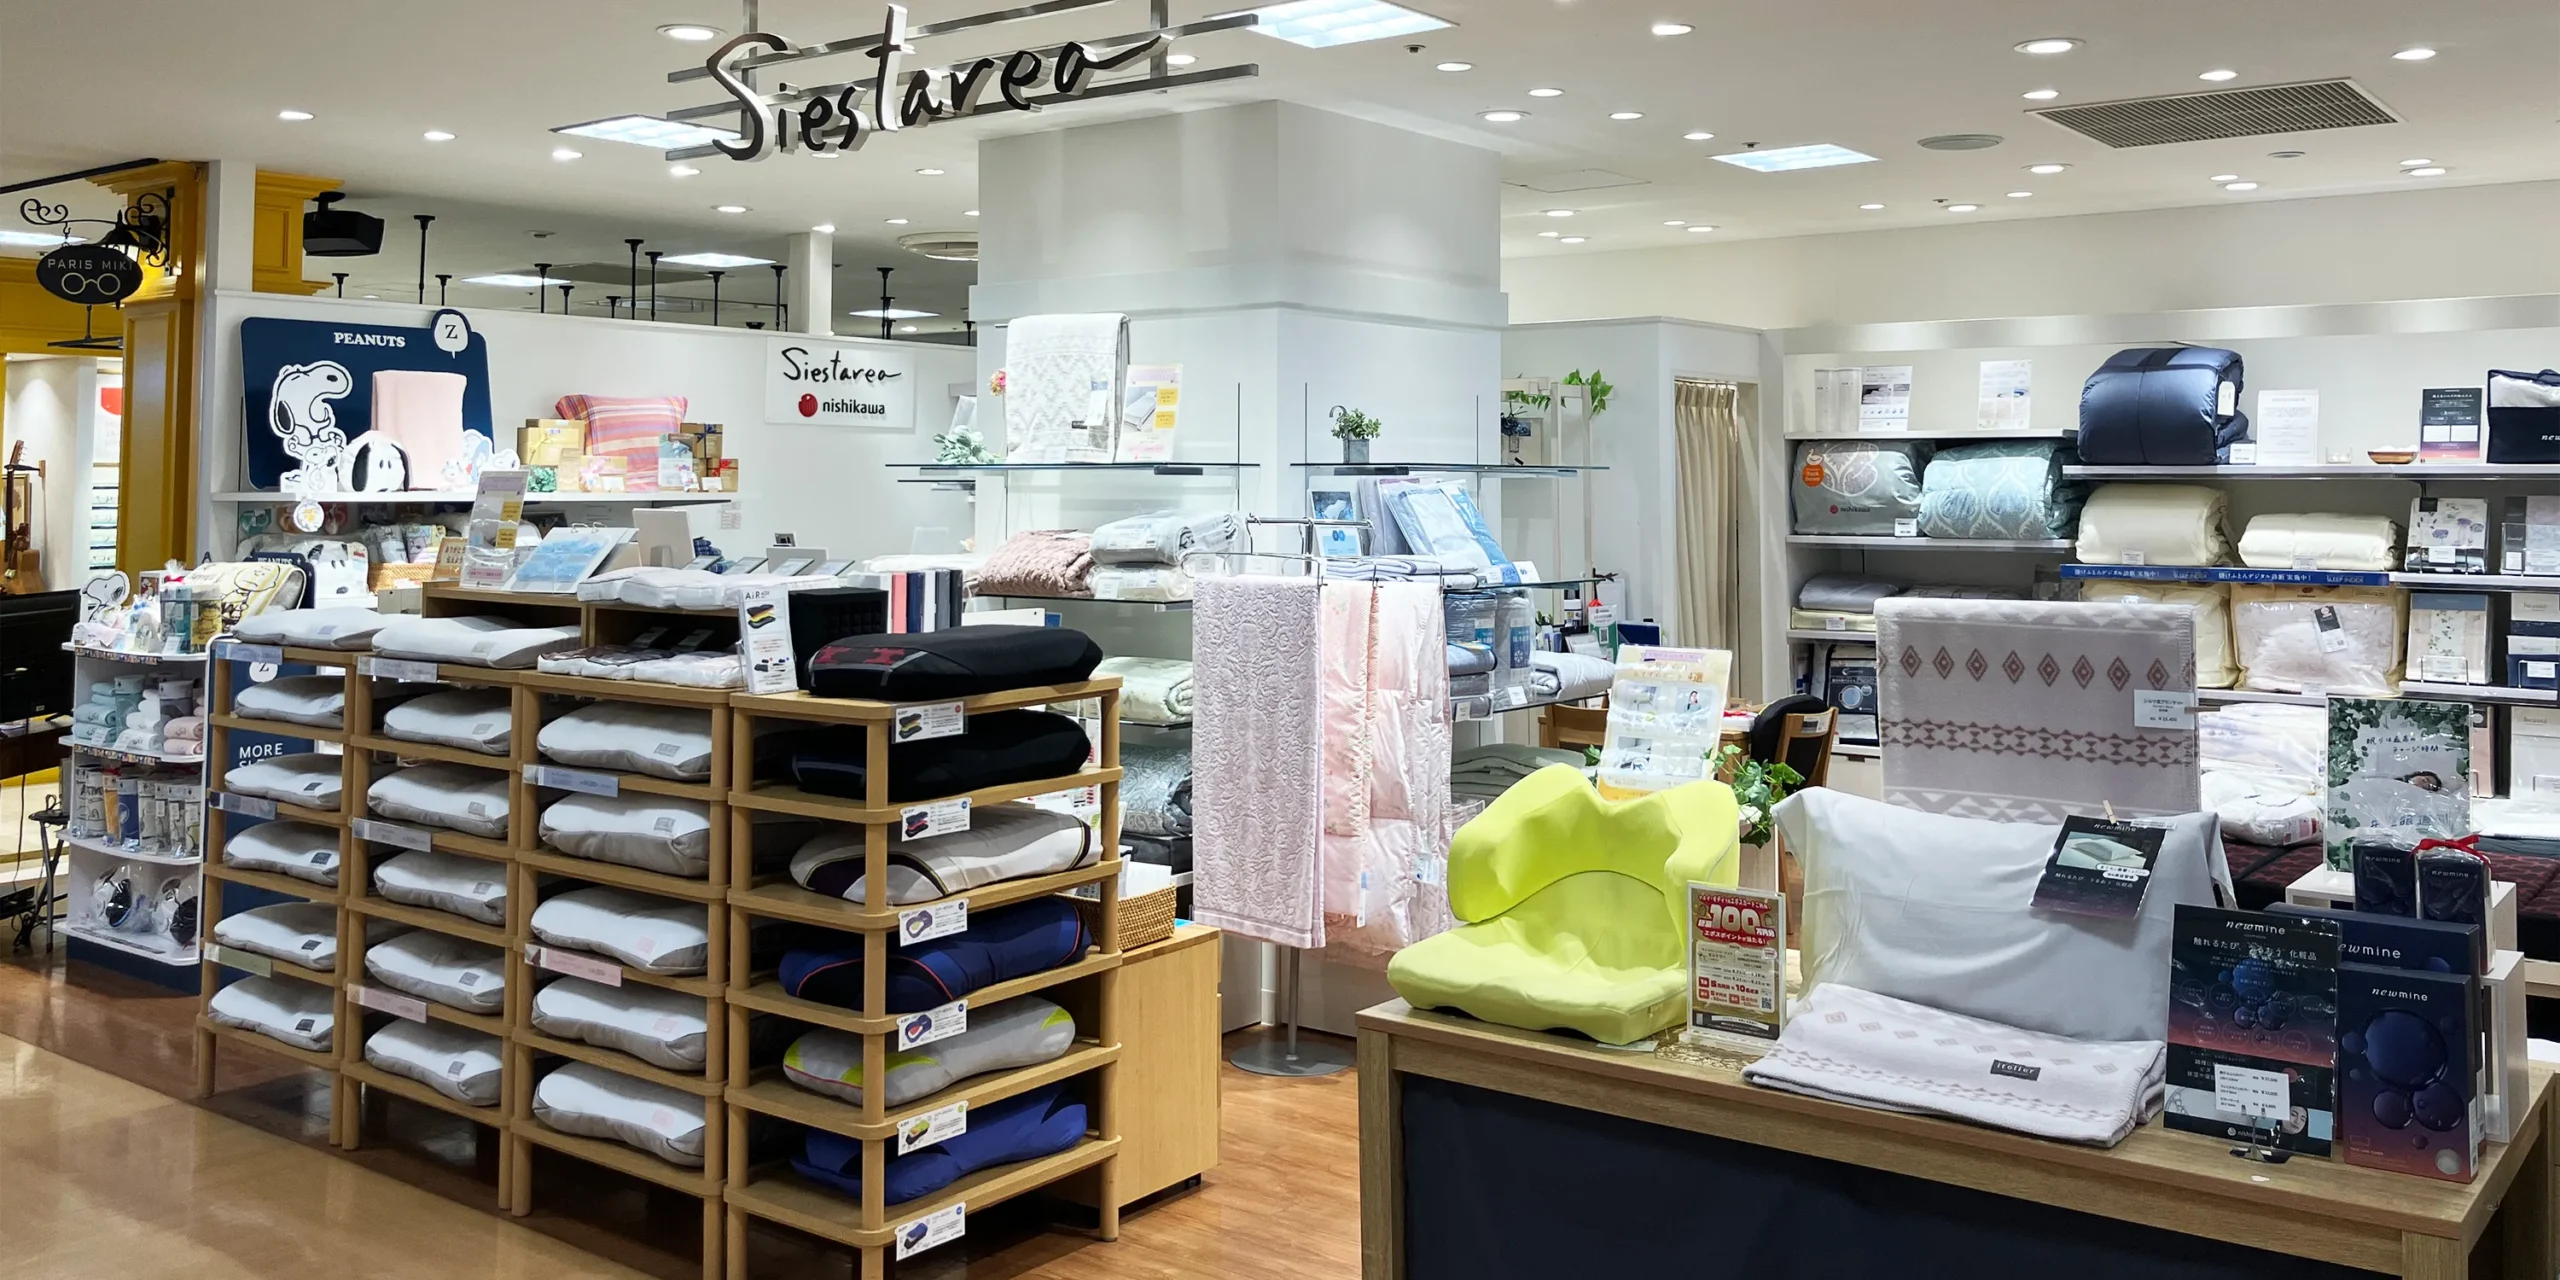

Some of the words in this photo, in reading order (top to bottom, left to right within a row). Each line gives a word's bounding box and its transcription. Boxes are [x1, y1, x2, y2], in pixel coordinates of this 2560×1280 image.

[706, 3, 1172, 161] Siestarea
[47, 259, 93, 270] PARIS
[102, 260, 133, 271] MIKI
[445, 324, 458, 339] Z
[333, 332, 406, 348] PEANUTS
[781, 347, 902, 383] Siestarea
[822, 398, 885, 415] nishikawa
[239, 743, 284, 760] MORE
[2093, 823, 2137, 832] newmine
[2365, 855, 2401, 863] newmine
[2431, 870, 2469, 878] newmine
[2225, 920, 2286, 935] newmine
[2337, 943, 2401, 959] ewmine
[2371, 987, 2428, 1002] newmine
